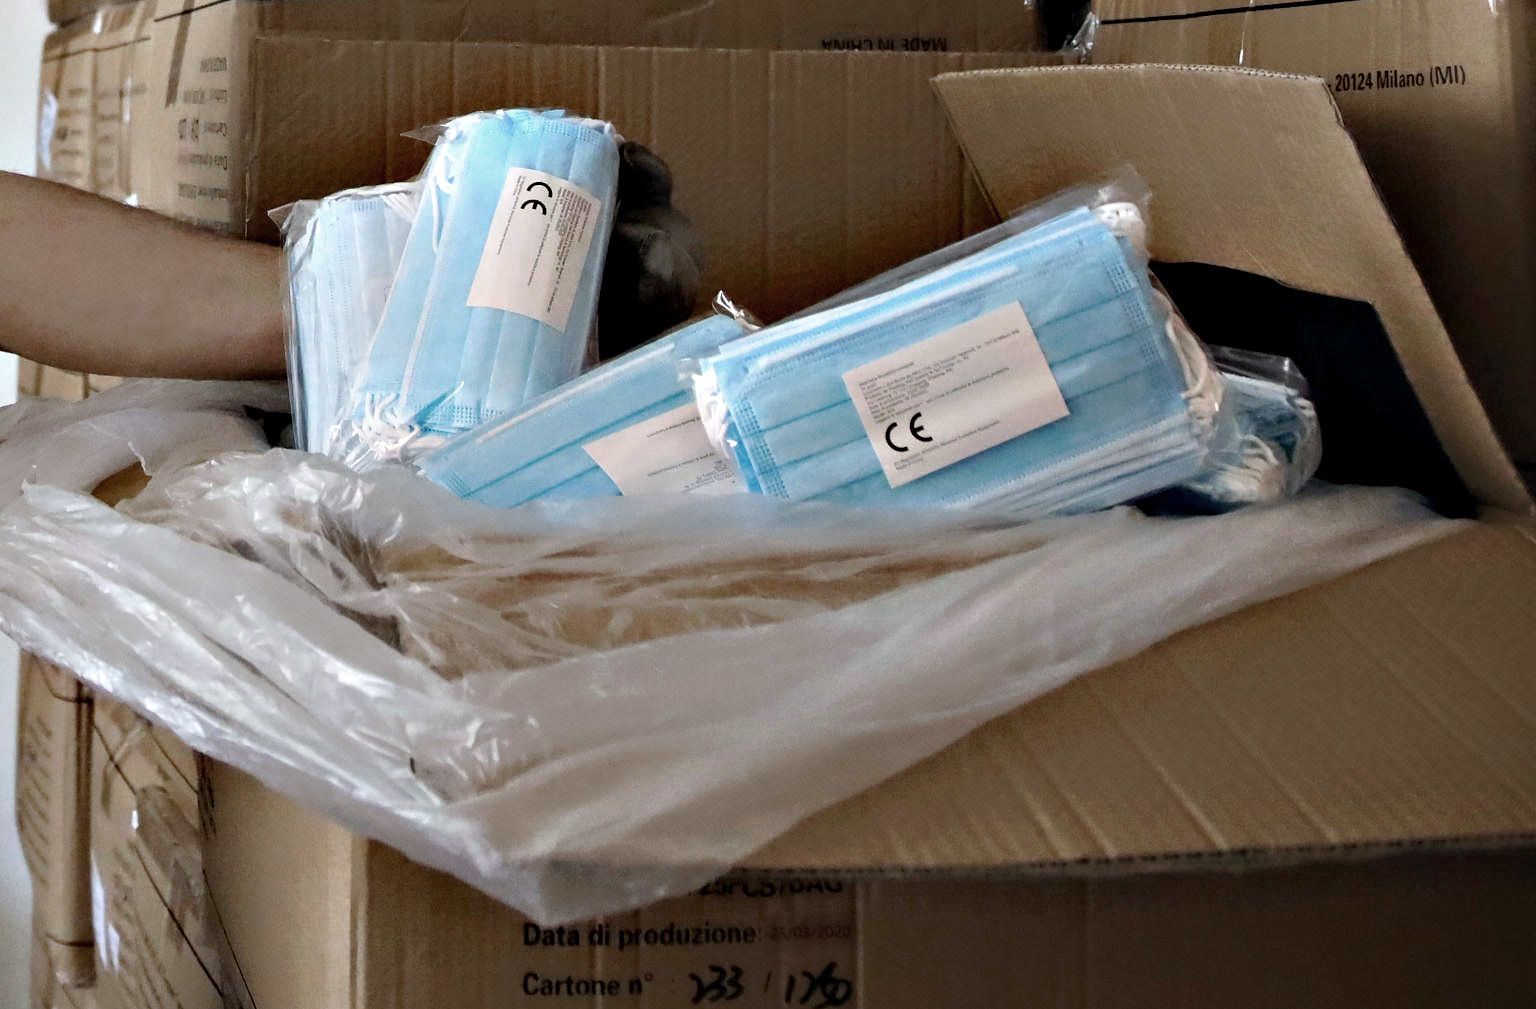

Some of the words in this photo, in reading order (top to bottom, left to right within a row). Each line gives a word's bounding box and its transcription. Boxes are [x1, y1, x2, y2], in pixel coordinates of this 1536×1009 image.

[1335, 72, 1374, 92] 20124
[1376, 68, 1425, 90] Milano
[1429, 65, 1467, 88] (MI)
[521, 922, 581, 947] Data
[588, 921, 611, 947] di
[521, 972, 621, 997] Cartone
